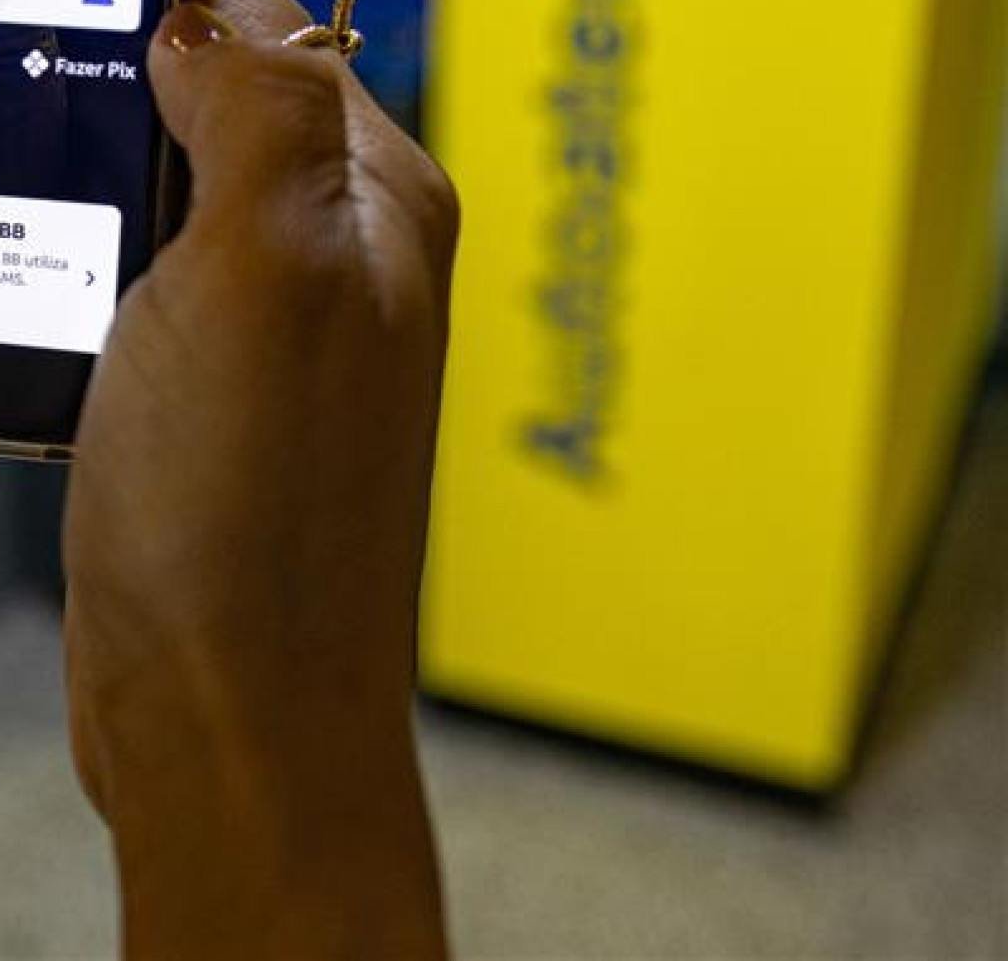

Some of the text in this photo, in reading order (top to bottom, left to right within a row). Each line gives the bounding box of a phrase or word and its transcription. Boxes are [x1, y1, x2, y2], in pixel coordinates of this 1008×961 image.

[55, 57, 137, 81] Fazer Pix
[0, 222, 26, 240] BB
[2, 252, 21, 266] BB
[25, 254, 69, 271] utiliza
